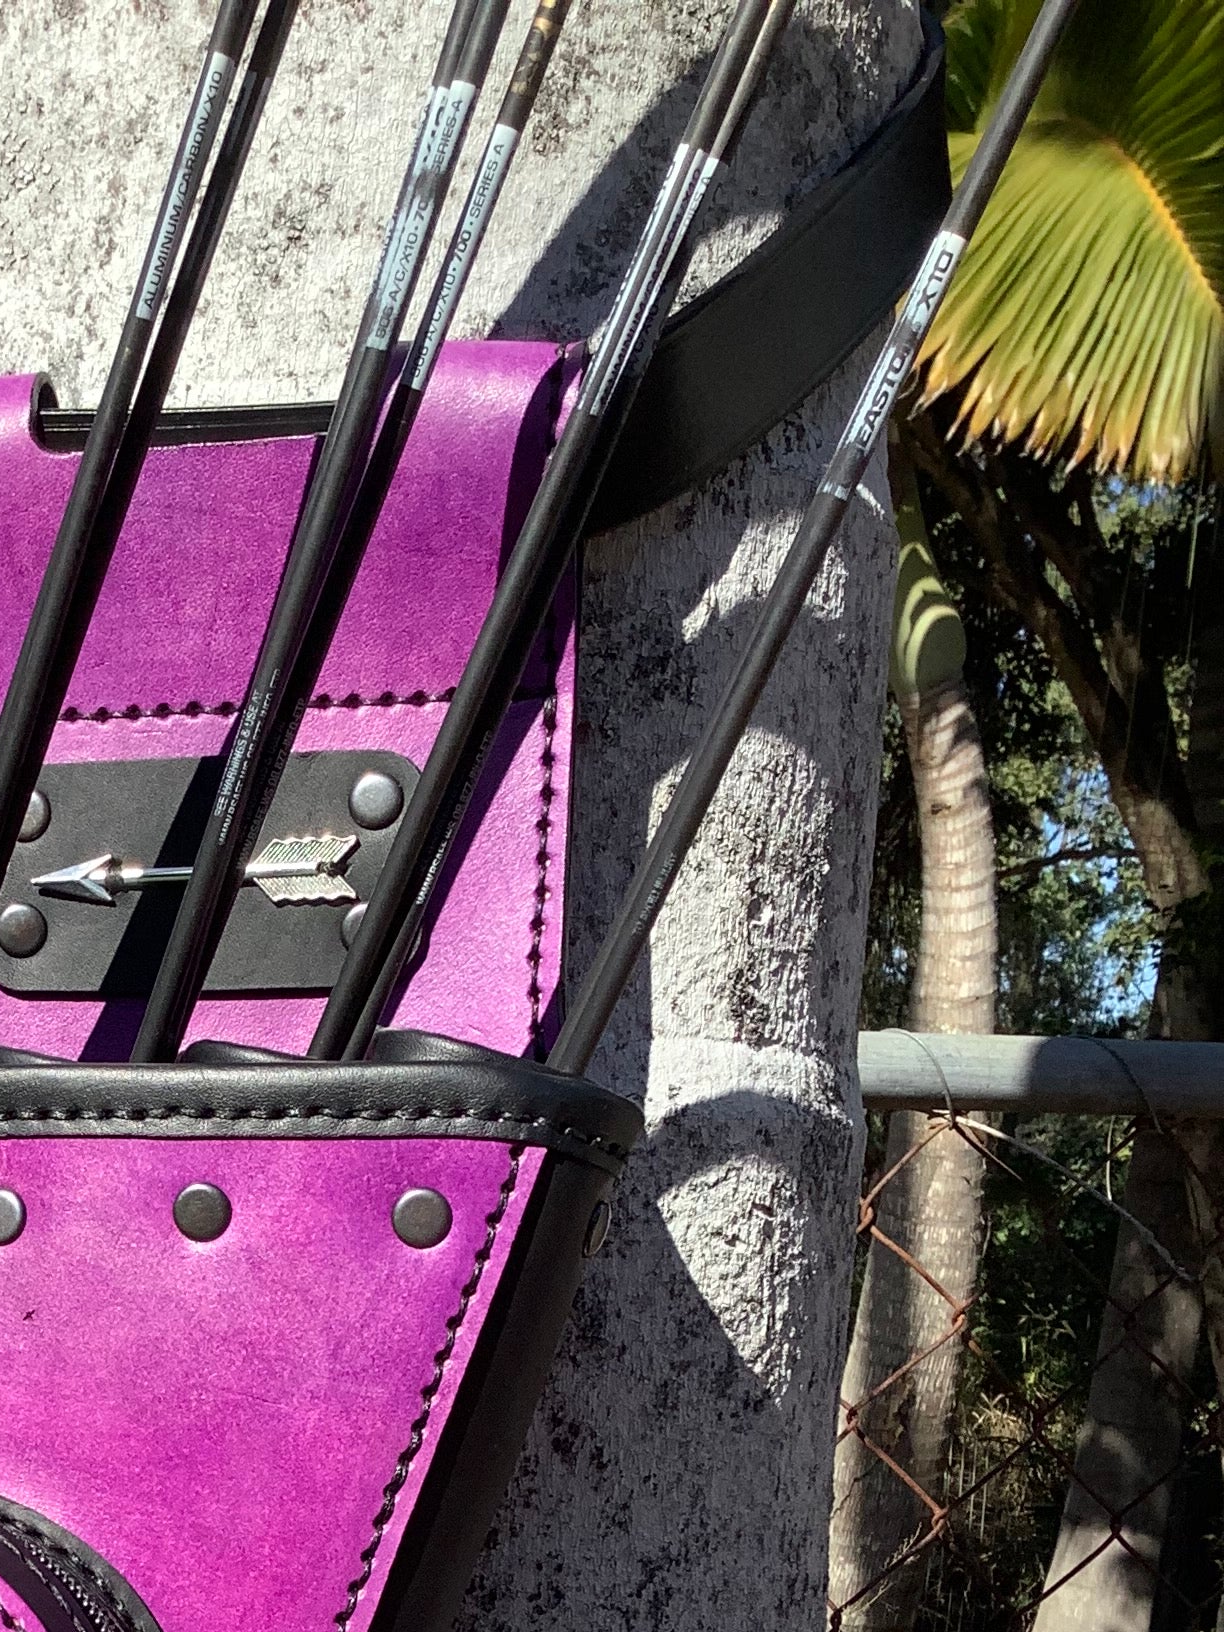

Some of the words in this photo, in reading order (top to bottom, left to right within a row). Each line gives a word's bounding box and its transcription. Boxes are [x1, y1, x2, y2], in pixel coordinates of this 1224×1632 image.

[141, 68, 224, 309] ALUMINUM/CARBON/X10
[386, 230, 419, 302] A/C/X10
[449, 96, 463, 112] A
[421, 271, 457, 342] A/C/X10
[452, 228, 473, 263] 700
[468, 158, 499, 219] SERIES
[491, 141, 505, 156] A
[852, 343, 912, 448] EASTO
[915, 248, 955, 310] X10
[219, 737, 248, 797] WARNINGS
[242, 703, 259, 728] USE
[250, 688, 263, 704] AT
